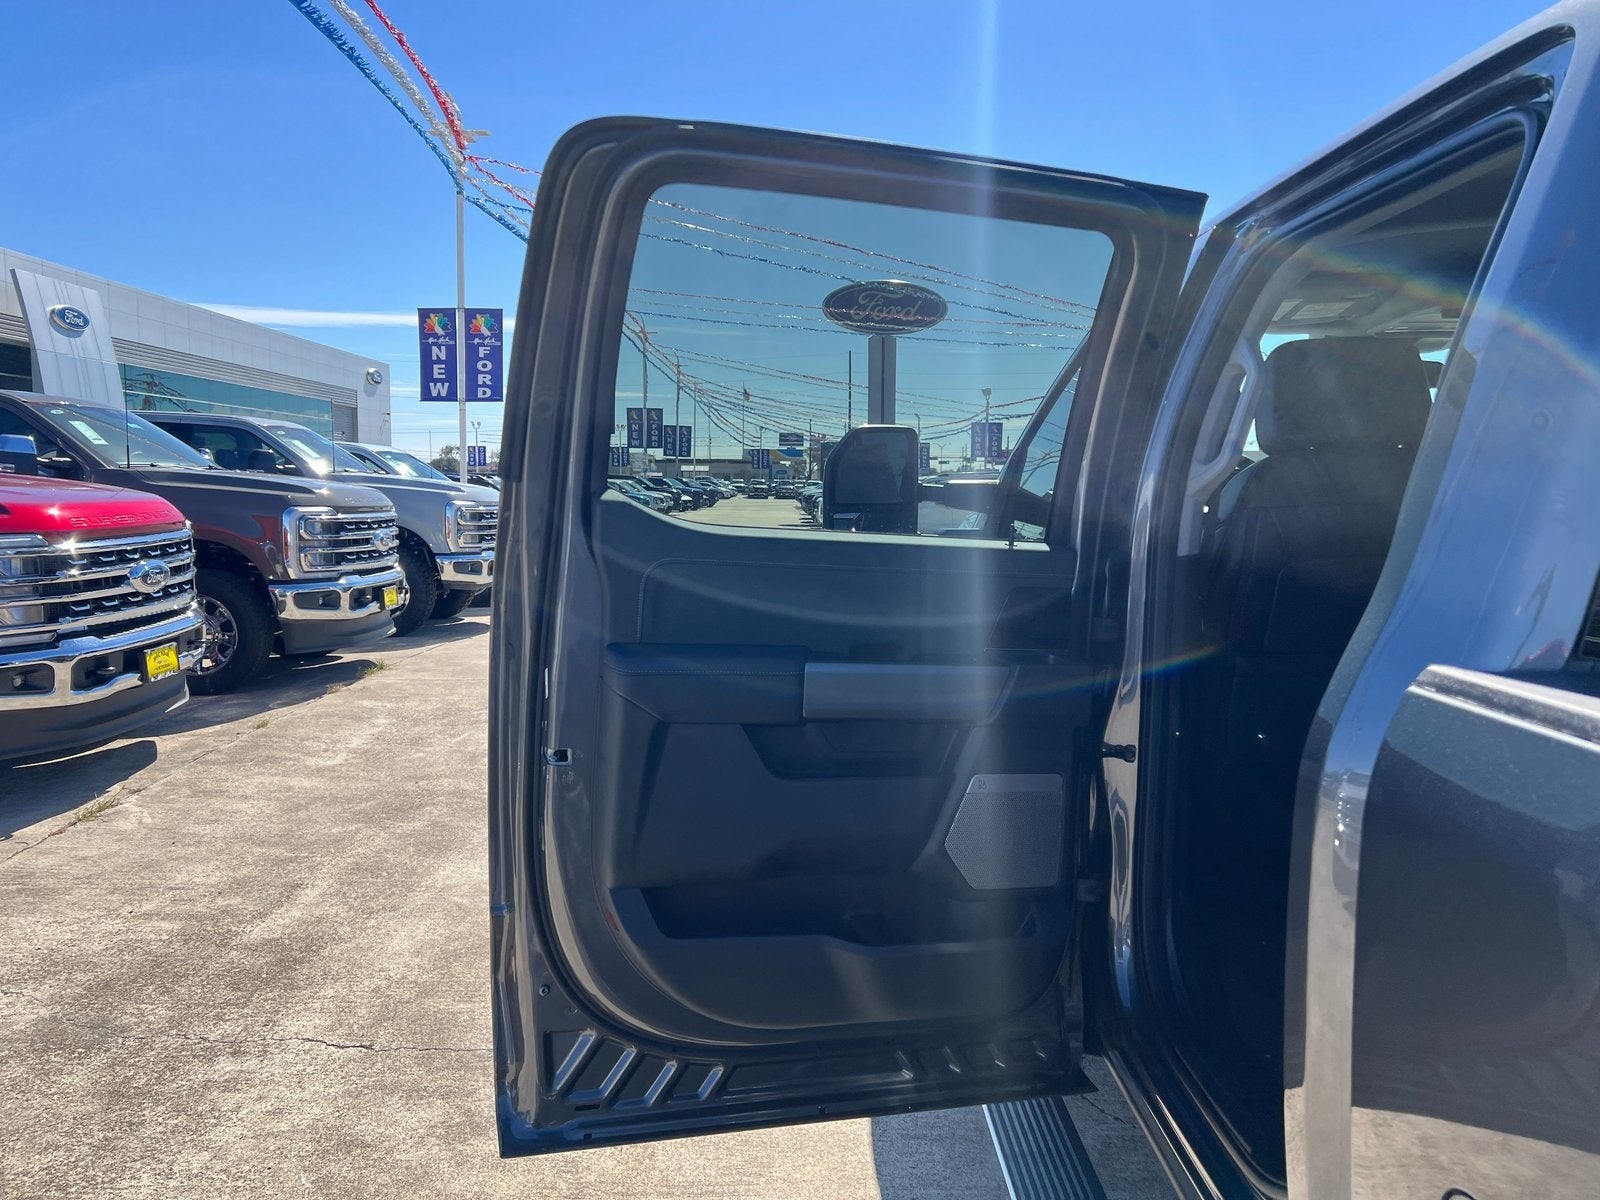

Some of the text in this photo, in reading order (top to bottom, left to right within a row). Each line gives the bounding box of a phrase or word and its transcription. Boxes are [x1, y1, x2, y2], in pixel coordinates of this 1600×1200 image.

[64, 309, 84, 326] Ford
[850, 290, 921, 321] Ford
[428, 345, 450, 397] NEW
[476, 346, 493, 399] FORD
[631, 423, 641, 447] NEW
[651, 423, 659, 447] FORD
[666, 435, 674, 456] NEW
[991, 436, 999, 457] FORD
[146, 569, 165, 584] Ford
